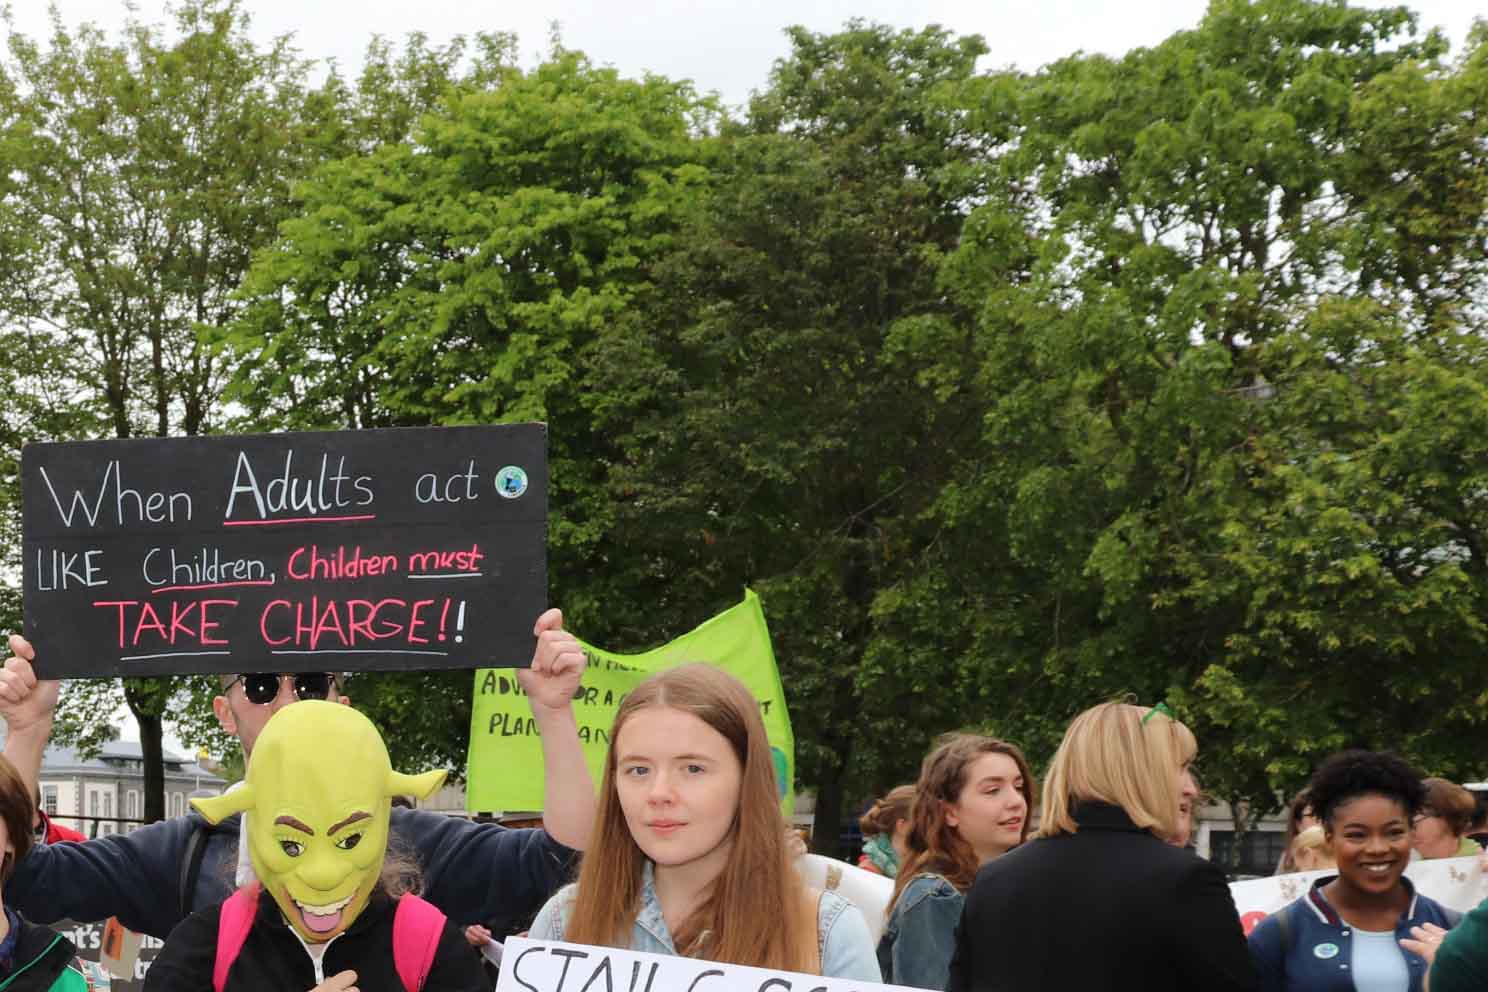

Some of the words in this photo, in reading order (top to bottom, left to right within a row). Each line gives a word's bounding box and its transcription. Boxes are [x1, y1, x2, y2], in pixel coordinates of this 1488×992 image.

[39, 460, 193, 528] When
[224, 450, 375, 520] Adults
[415, 459, 480, 504] act
[37, 548, 109, 591] LIKE
[287, 544, 397, 581] Children
[408, 543, 484, 573] must
[92, 599, 239, 649] TAKE
